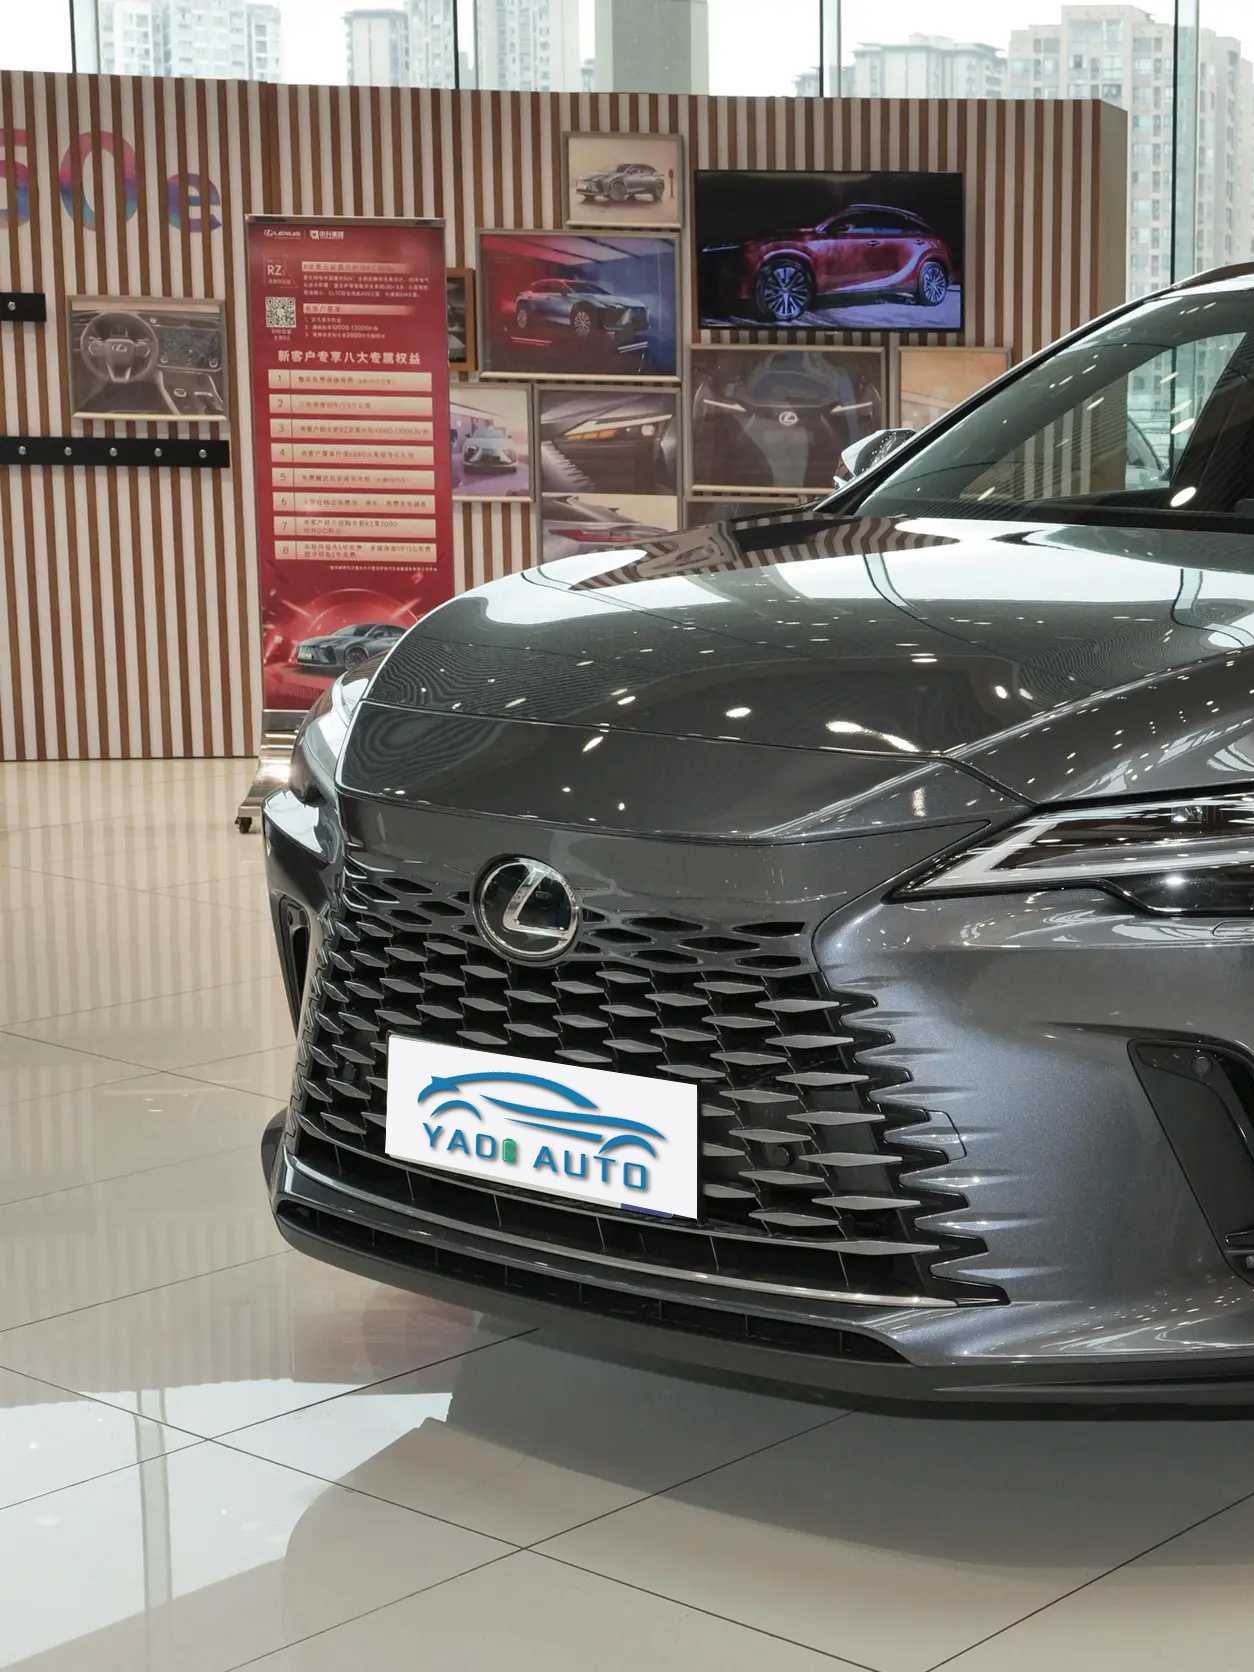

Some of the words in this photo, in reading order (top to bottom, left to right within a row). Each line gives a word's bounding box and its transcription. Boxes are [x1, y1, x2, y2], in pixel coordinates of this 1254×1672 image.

[267, 264, 283, 277] RZ
[278, 350, 421, 365] 新客户专享八大专属权益
